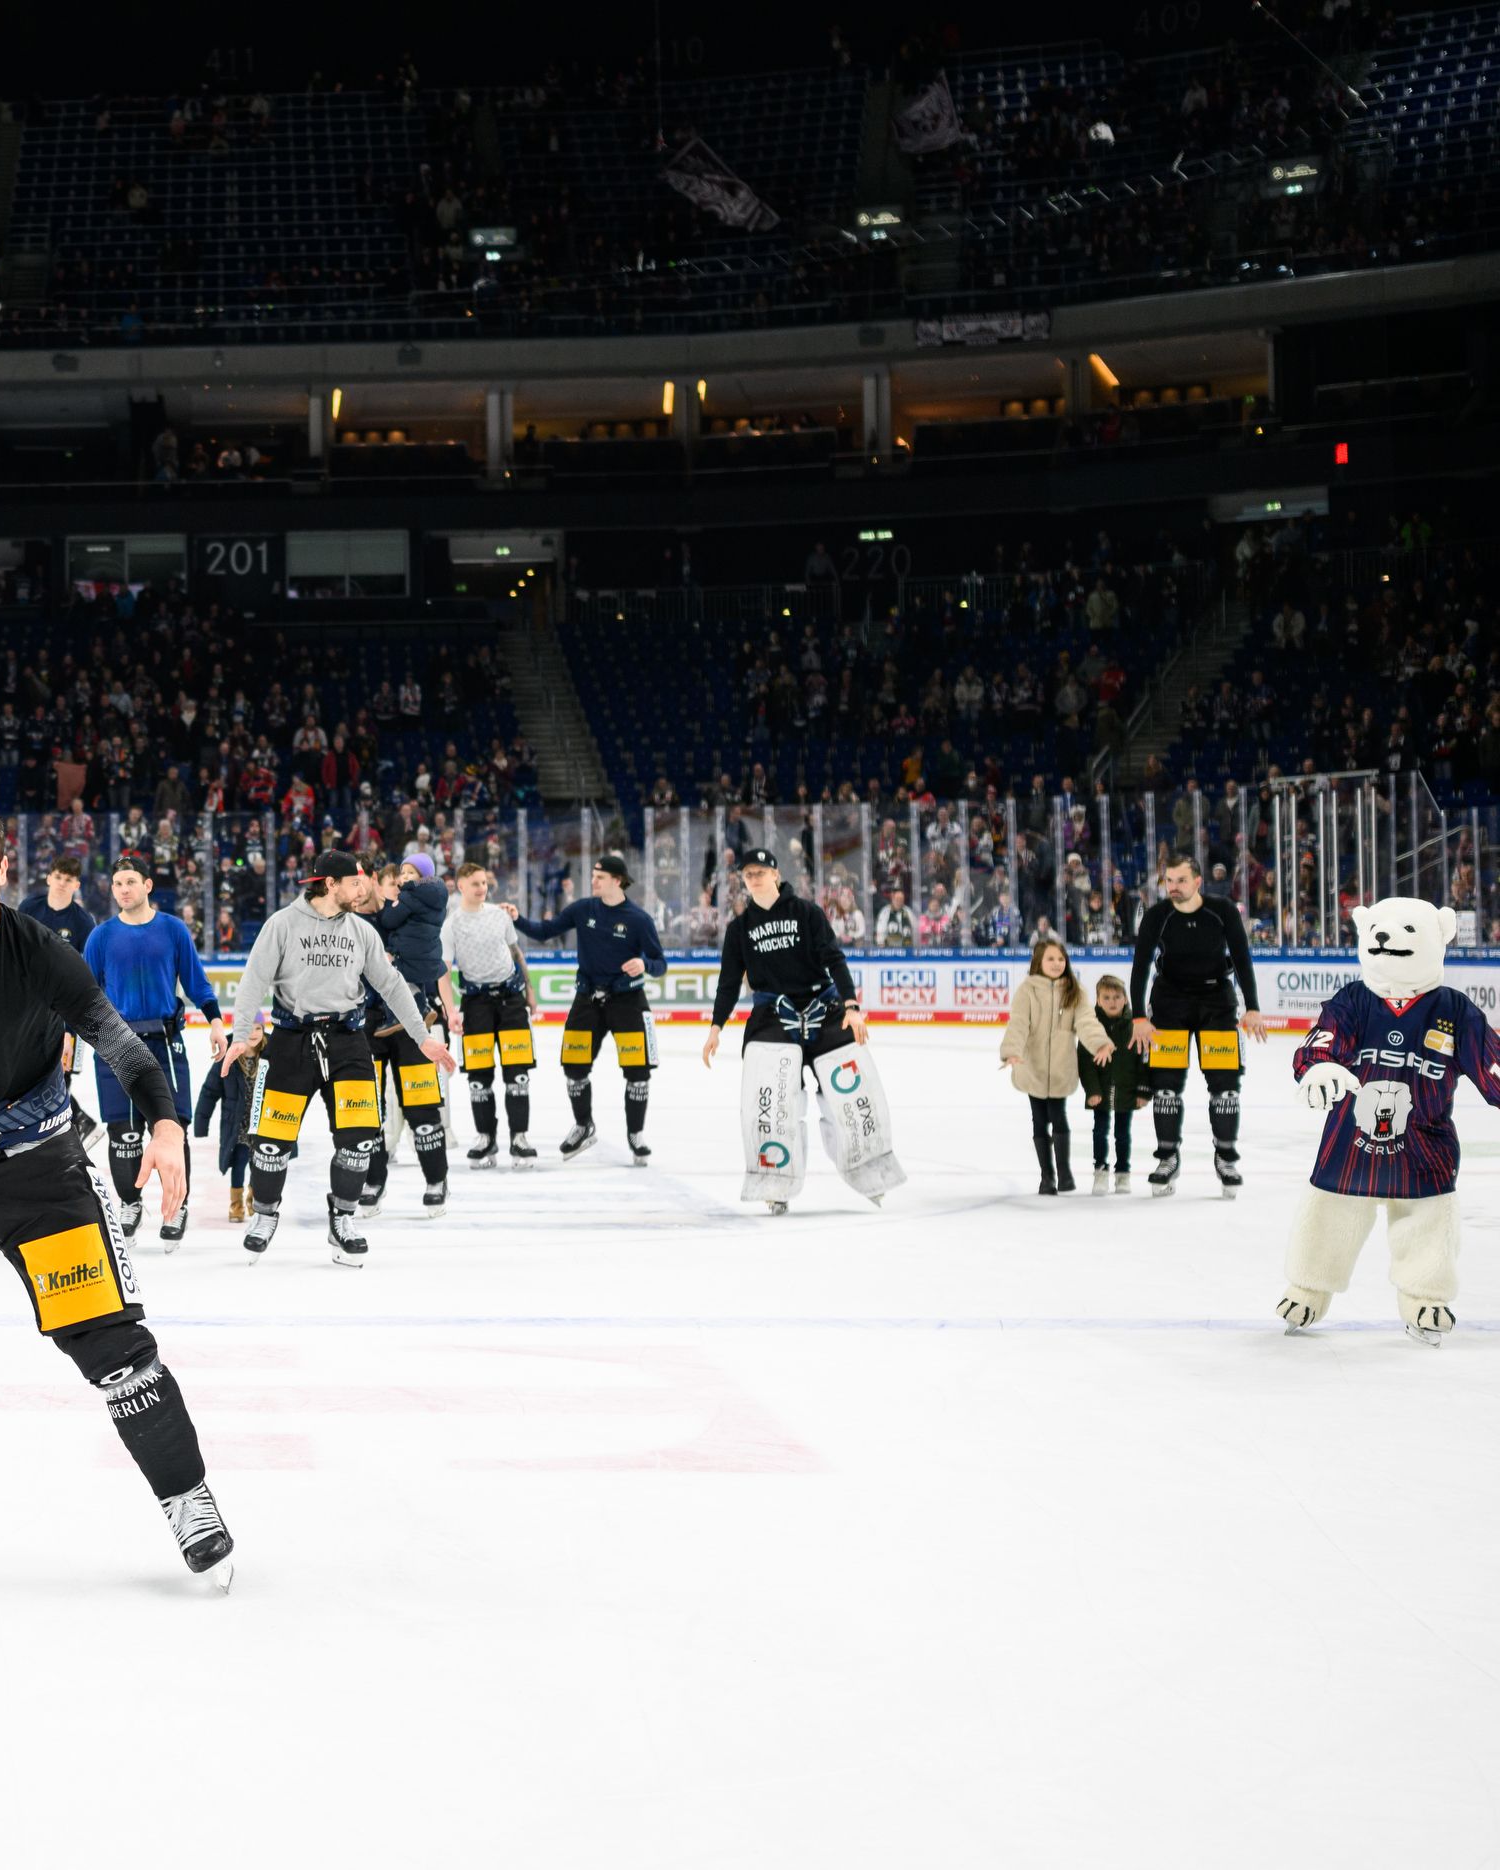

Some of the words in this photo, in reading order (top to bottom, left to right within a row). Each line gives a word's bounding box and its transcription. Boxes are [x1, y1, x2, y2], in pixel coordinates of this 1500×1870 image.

[206, 541, 268, 575] 201
[841, 544, 912, 580] 220
[749, 919, 799, 942] WARRIOR
[300, 934, 355, 953] WARRIOR
[758, 935, 797, 953] HOCKEY
[306, 953, 350, 968] HOCKEY
[882, 969, 936, 986] LIQUI
[956, 969, 1008, 986] LIQUI
[882, 987, 936, 1005] MOLY
[956, 987, 1008, 1005] MOLY
[1160, 1044, 1187, 1054] Knittel
[1208, 1045, 1236, 1055] Knittel
[1353, 1048, 1446, 1080] ASAG
[410, 1080, 436, 1089] Knittel
[252, 1064, 268, 1128] CONTIPARK
[345, 1098, 374, 1109] Knittel
[775, 1057, 792, 1137] engineering
[271, 1110, 300, 1124] Knittel
[758, 1086, 772, 1135] arxes
[856, 1096, 876, 1137] arxes
[1354, 1136, 1406, 1155] BERLIN
[91, 1173, 135, 1295] CONTIPARK
[48, 1259, 104, 1291] Knittel
[108, 1388, 161, 1419] BERLIN
